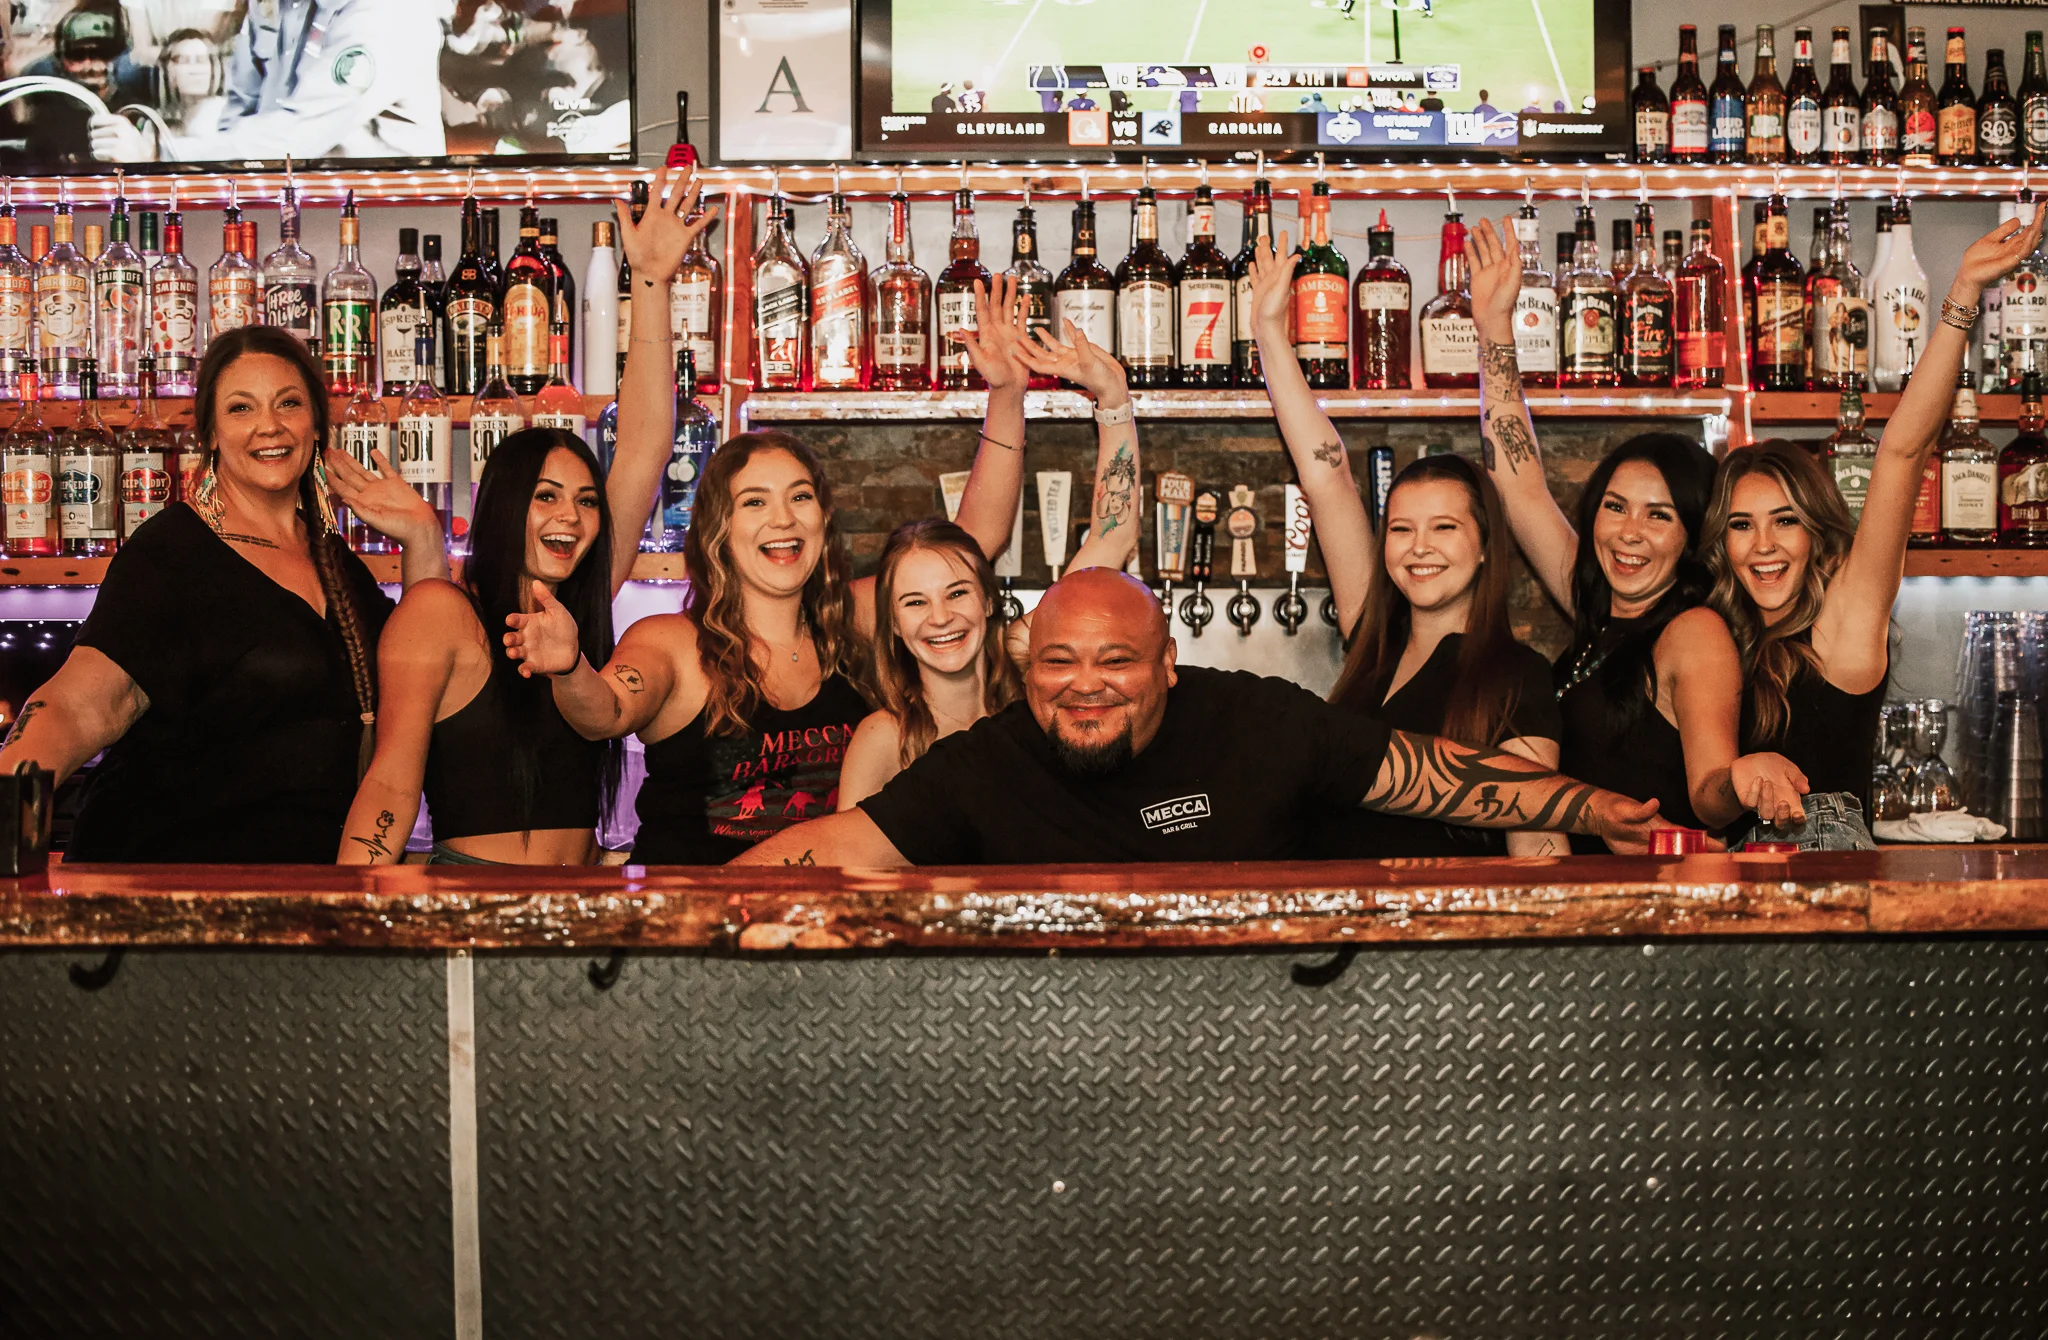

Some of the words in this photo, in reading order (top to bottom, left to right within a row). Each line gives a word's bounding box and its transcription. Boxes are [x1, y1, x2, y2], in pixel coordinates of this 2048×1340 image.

[754, 55, 814, 113] A
[1295, 69, 1325, 87] 4TH
[1370, 71, 1415, 82] TOYOTA
[957, 123, 1045, 135] CLEVELAND
[1208, 122, 1283, 135] CAROLINA
[1981, 120, 2017, 141] 805
[1200, 215, 1211, 232] 7
[833, 284, 859, 298] LABEL
[1297, 279, 1345, 296] JAMESON
[1187, 301, 1225, 359] 7
[1445, 332, 1480, 343] Mark
[399, 430, 433, 462] SON
[1952, 472, 1967, 484] JACK
[1145, 799, 1207, 824] MECCA
[1162, 826, 1175, 835] BAR
[1180, 821, 1198, 831] GRILL
